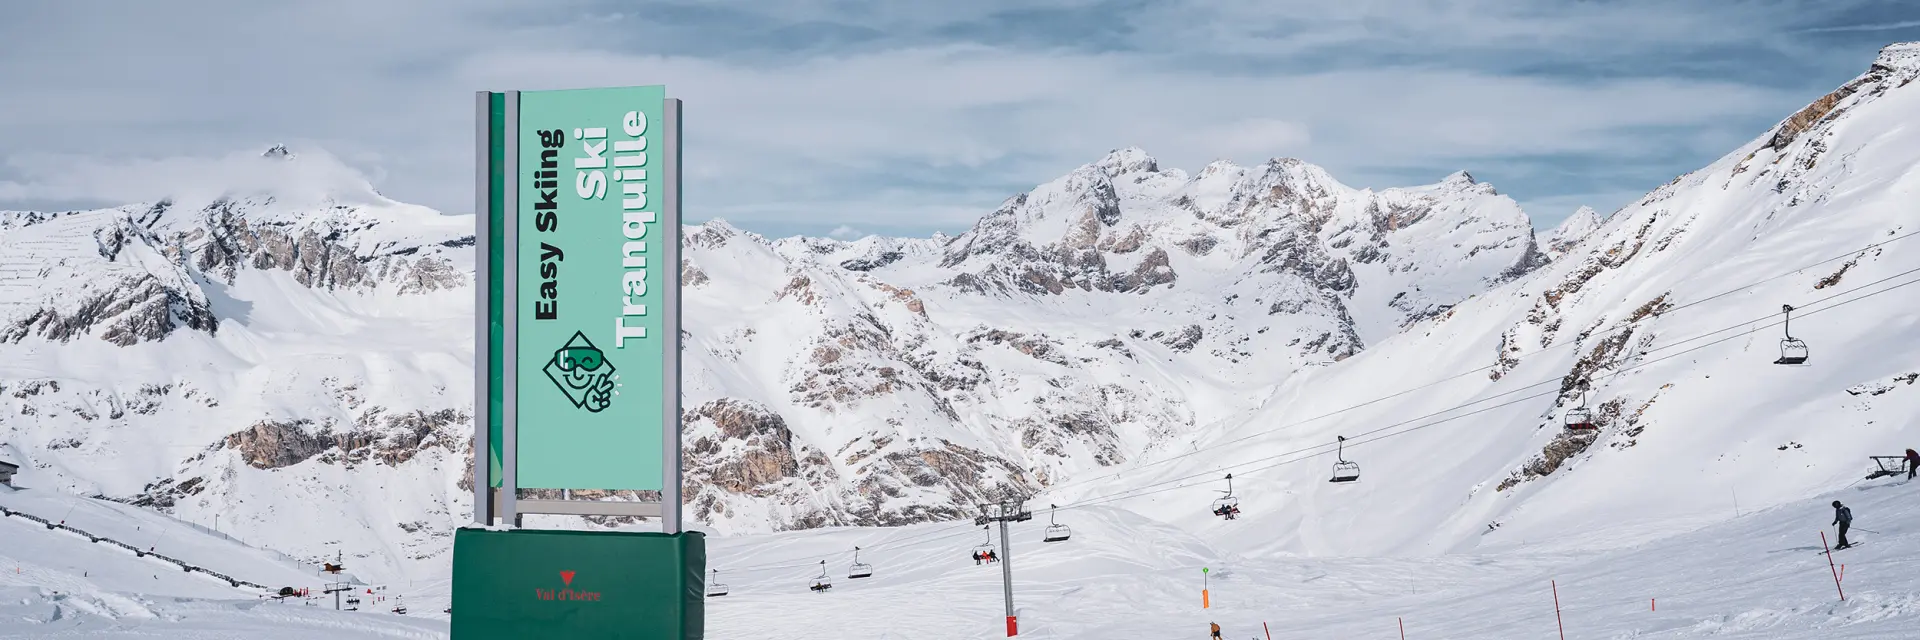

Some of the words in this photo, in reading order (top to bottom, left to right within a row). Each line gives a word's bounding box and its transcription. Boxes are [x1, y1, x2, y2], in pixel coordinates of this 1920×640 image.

[534, 129, 565, 233] Skiing
[574, 127, 608, 201] Ski
[613, 110, 656, 349] Tranquille
[534, 242, 564, 320] Easy
[535, 588, 555, 601] Val
[558, 588, 601, 601] d'Isère
